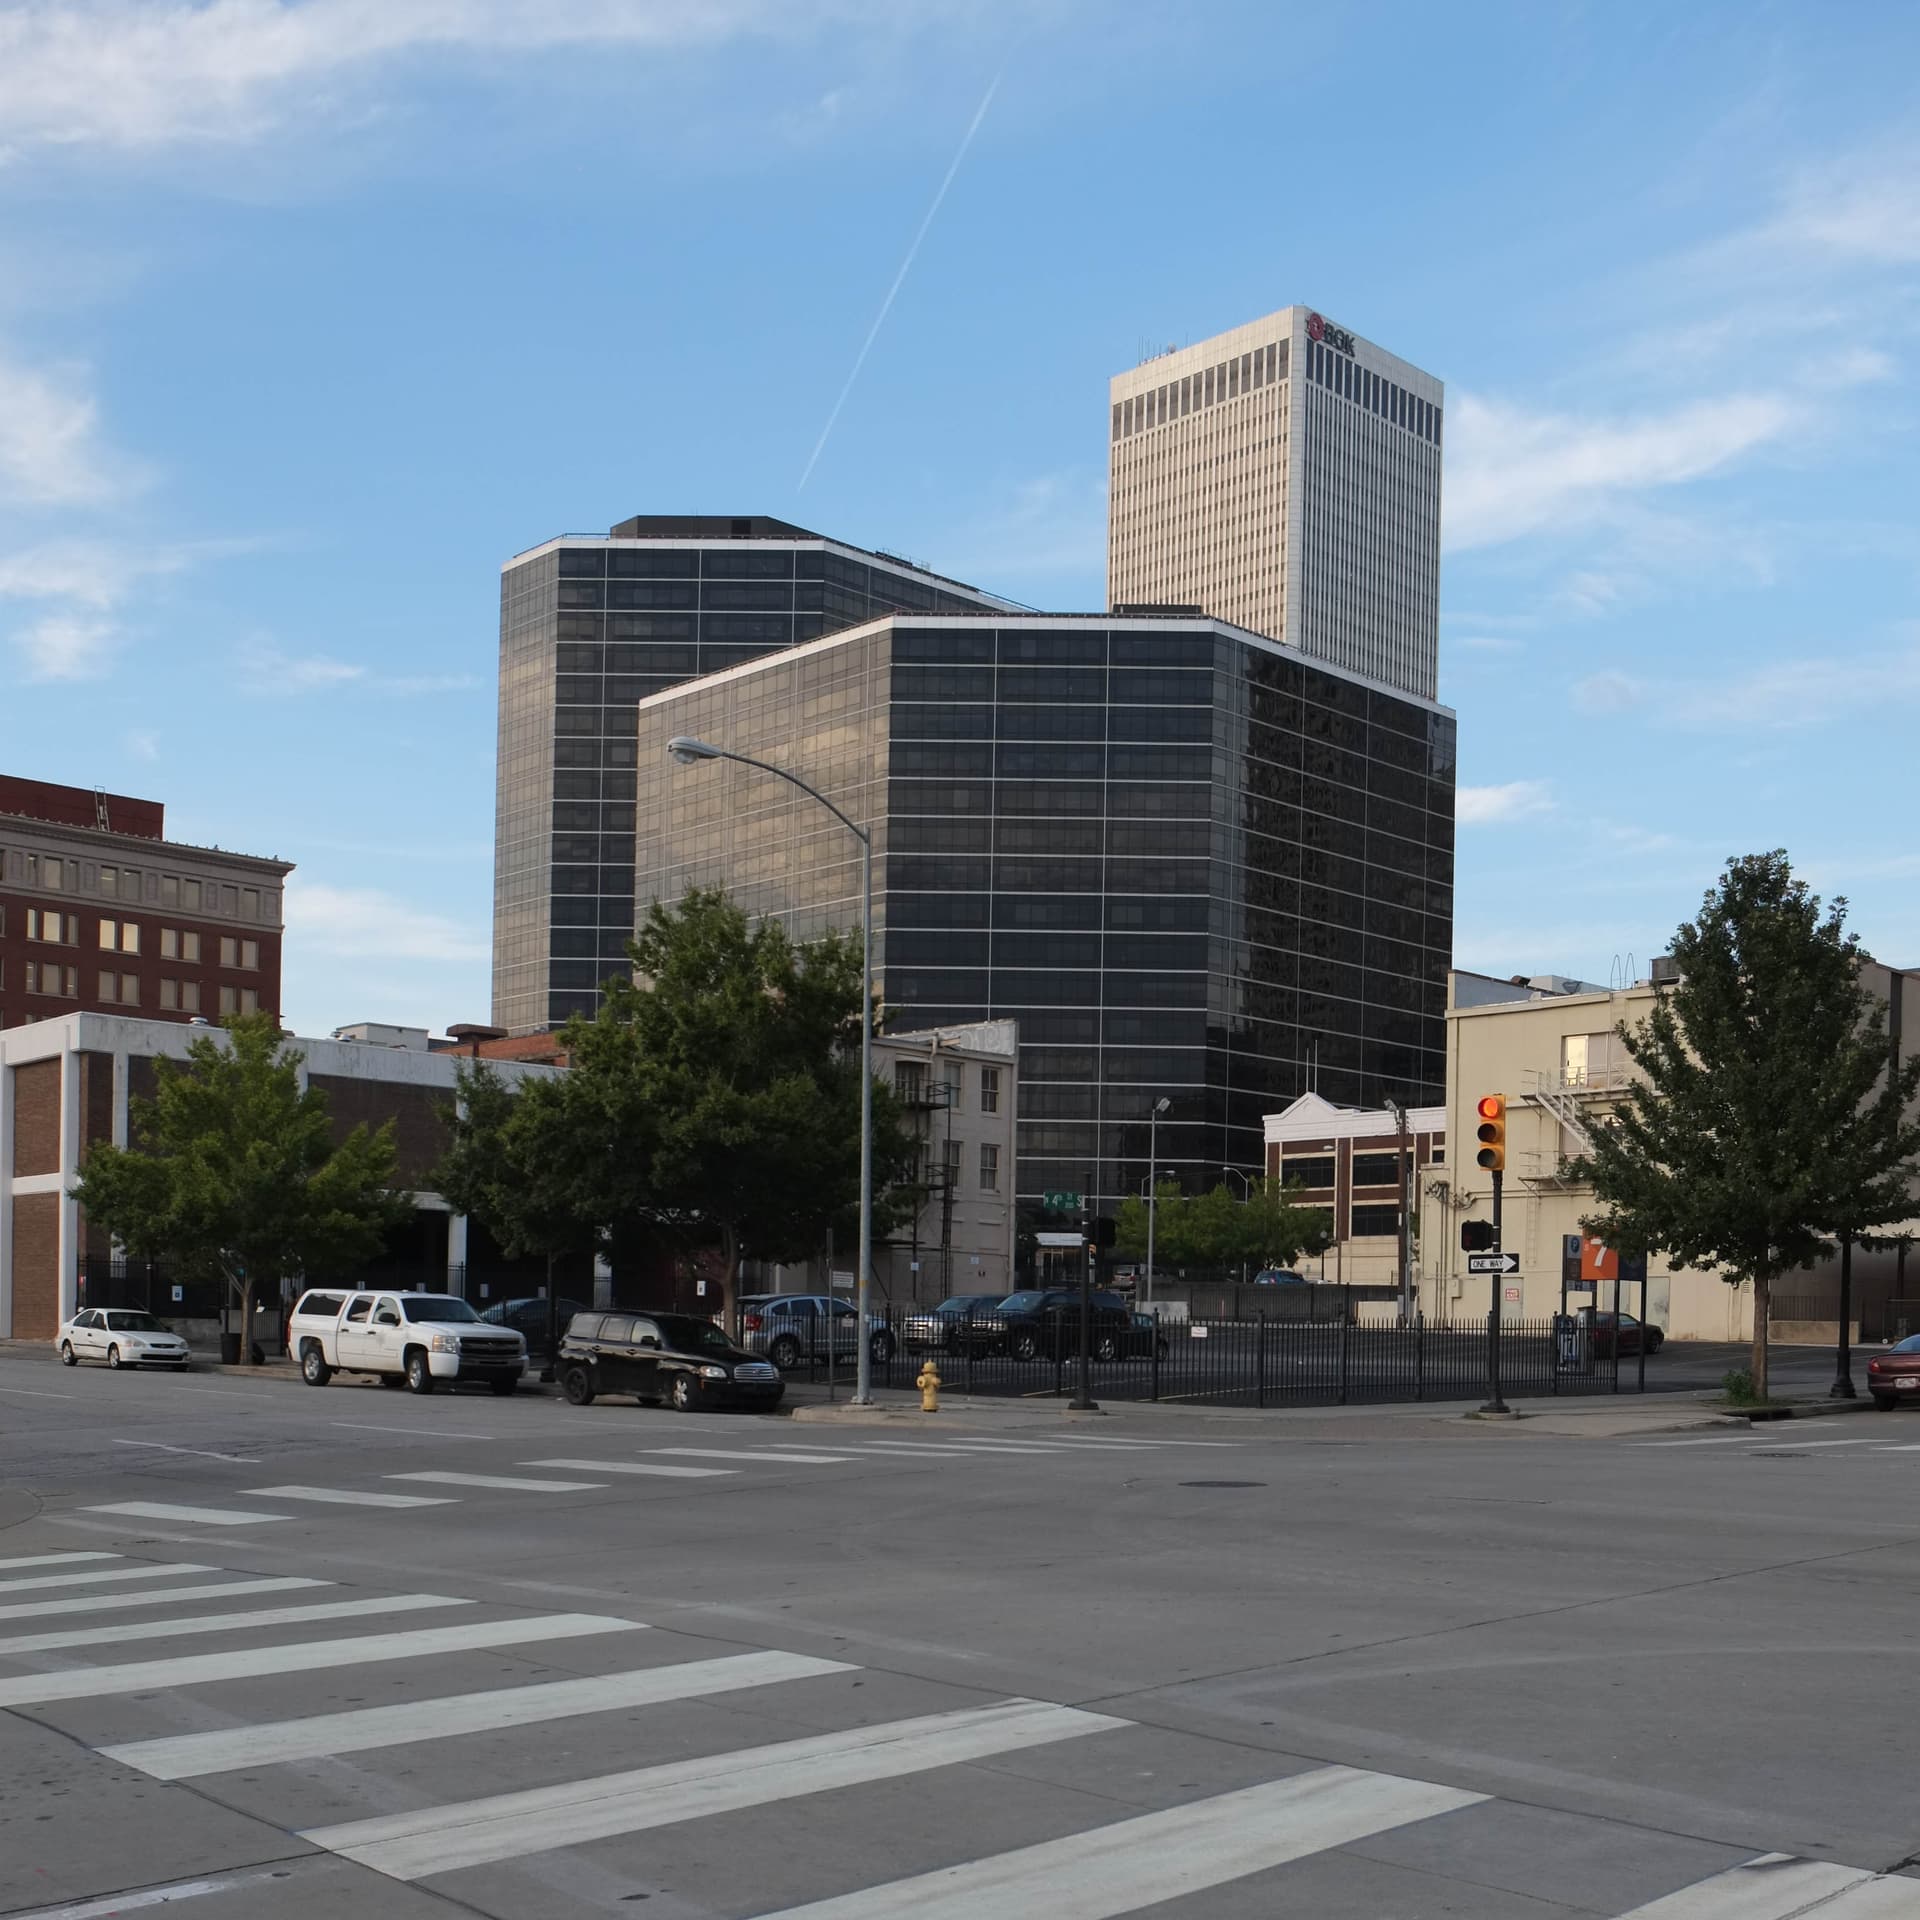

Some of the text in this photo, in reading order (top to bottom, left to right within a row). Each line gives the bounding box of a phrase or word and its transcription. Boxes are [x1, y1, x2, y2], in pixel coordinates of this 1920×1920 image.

[1325, 322, 1356, 358] BOK
[1473, 1259, 1504, 1268] ONE WAY
